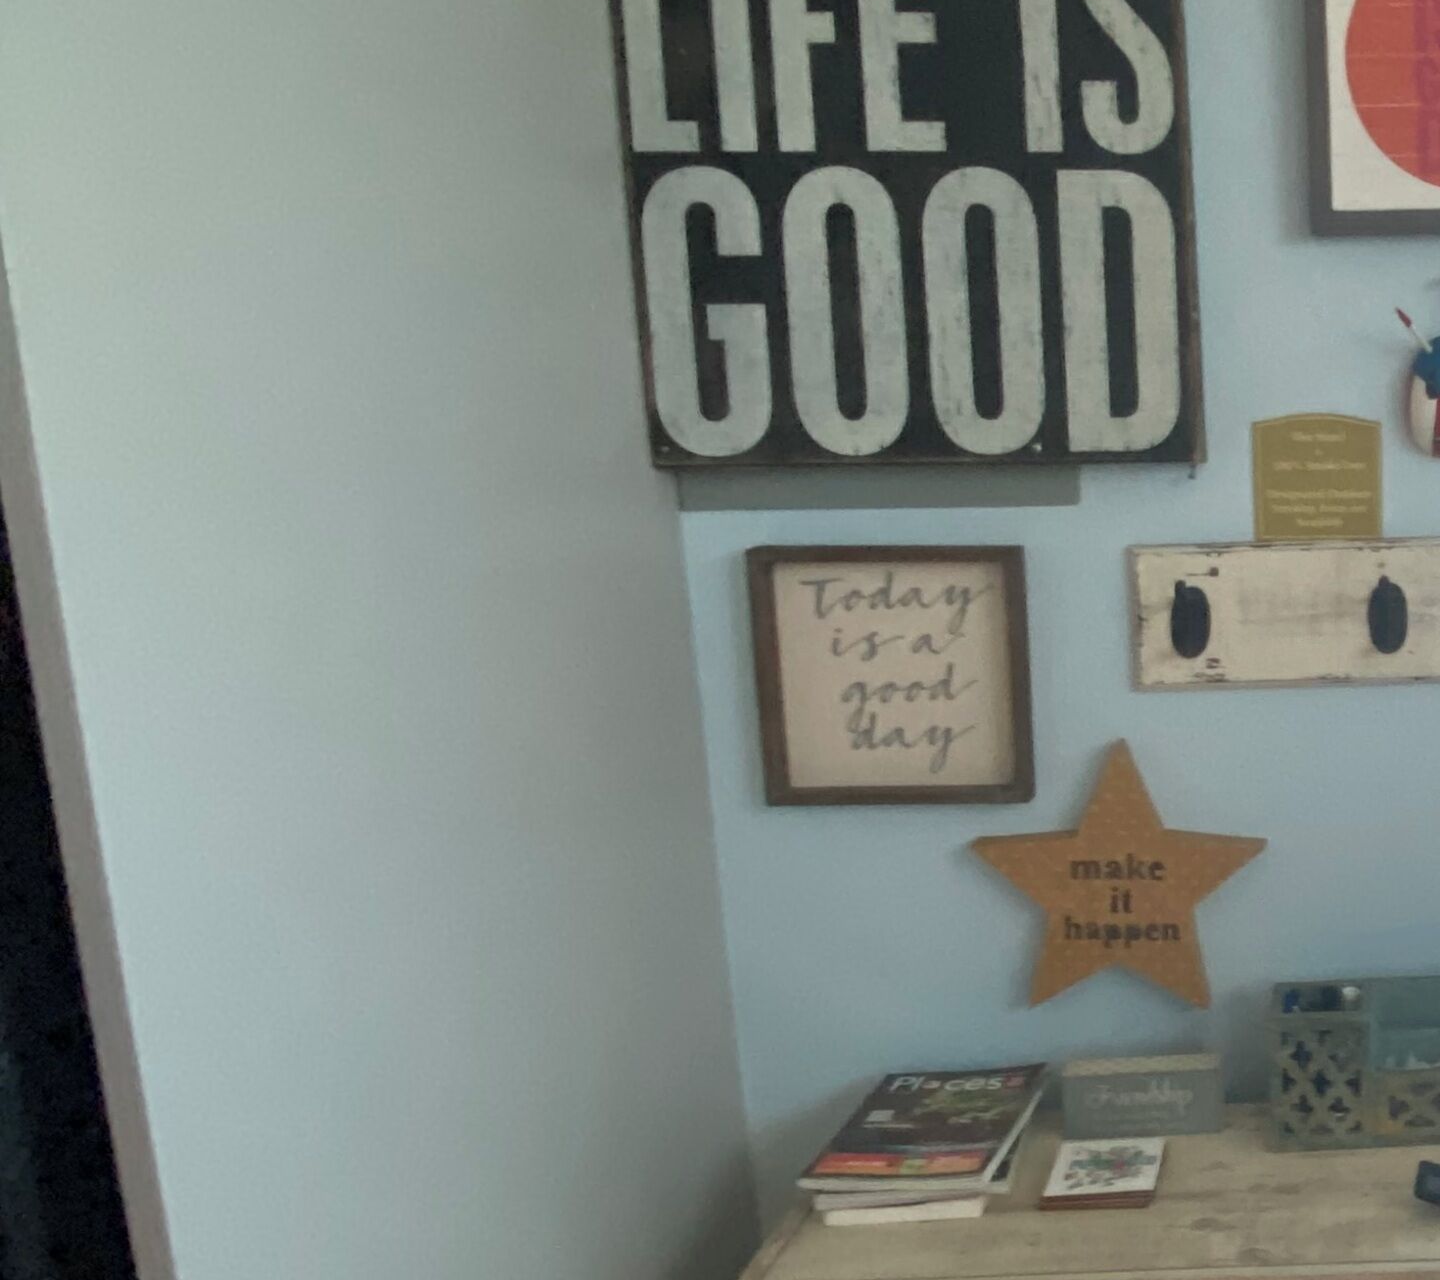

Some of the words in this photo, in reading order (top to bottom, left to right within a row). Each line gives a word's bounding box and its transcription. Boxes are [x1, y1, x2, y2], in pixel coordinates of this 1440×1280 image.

[641, 165, 1181, 457] GOOD
[800, 571, 994, 634] Today
[831, 628, 904, 661] is
[911, 632, 965, 654] a
[840, 663, 978, 734] good
[851, 711, 975, 774] day
[1069, 853, 1167, 881] make
[1109, 887, 1133, 913] it
[1063, 915, 1182, 949] happen
